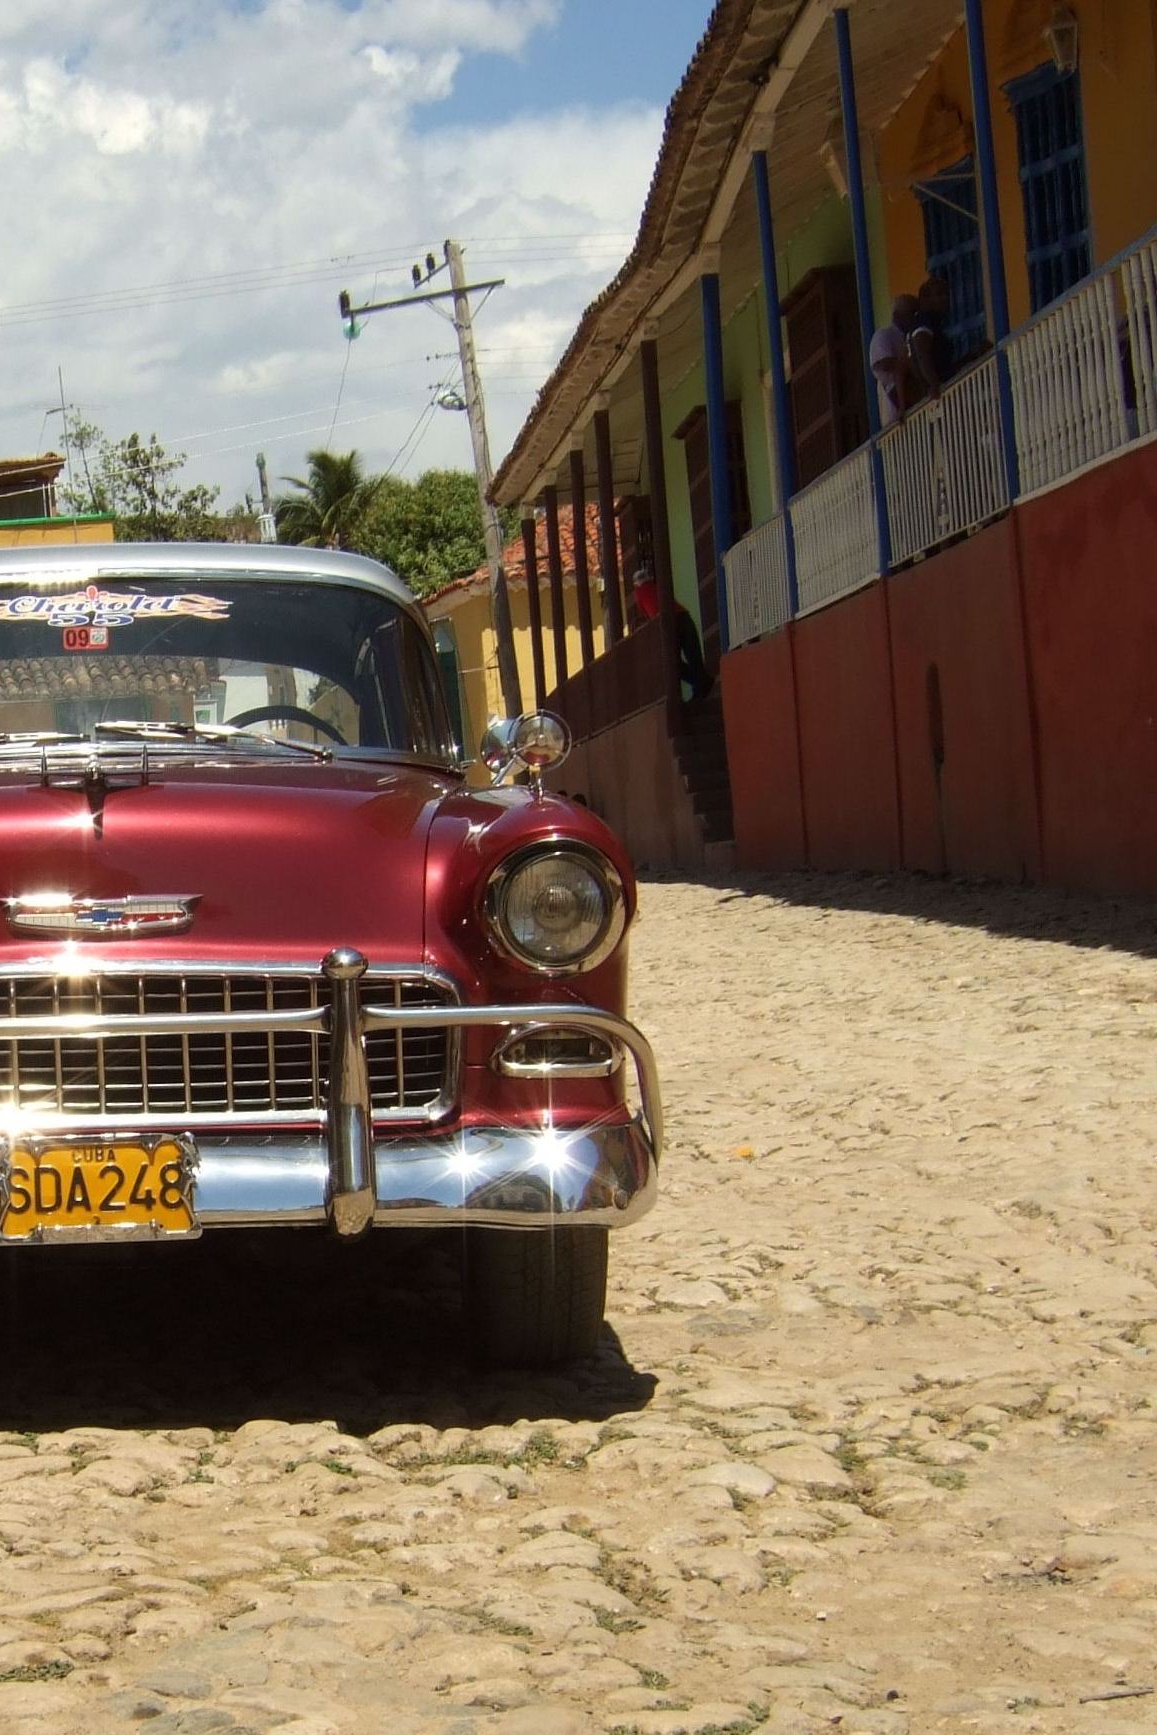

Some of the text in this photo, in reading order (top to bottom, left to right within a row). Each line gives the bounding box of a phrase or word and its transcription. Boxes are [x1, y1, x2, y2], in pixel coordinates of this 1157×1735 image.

[6, 594, 180, 615] Chevrolet
[47, 613, 134, 627] 55
[65, 629, 90, 647] 09
[71, 1146, 117, 1163] CUBA
